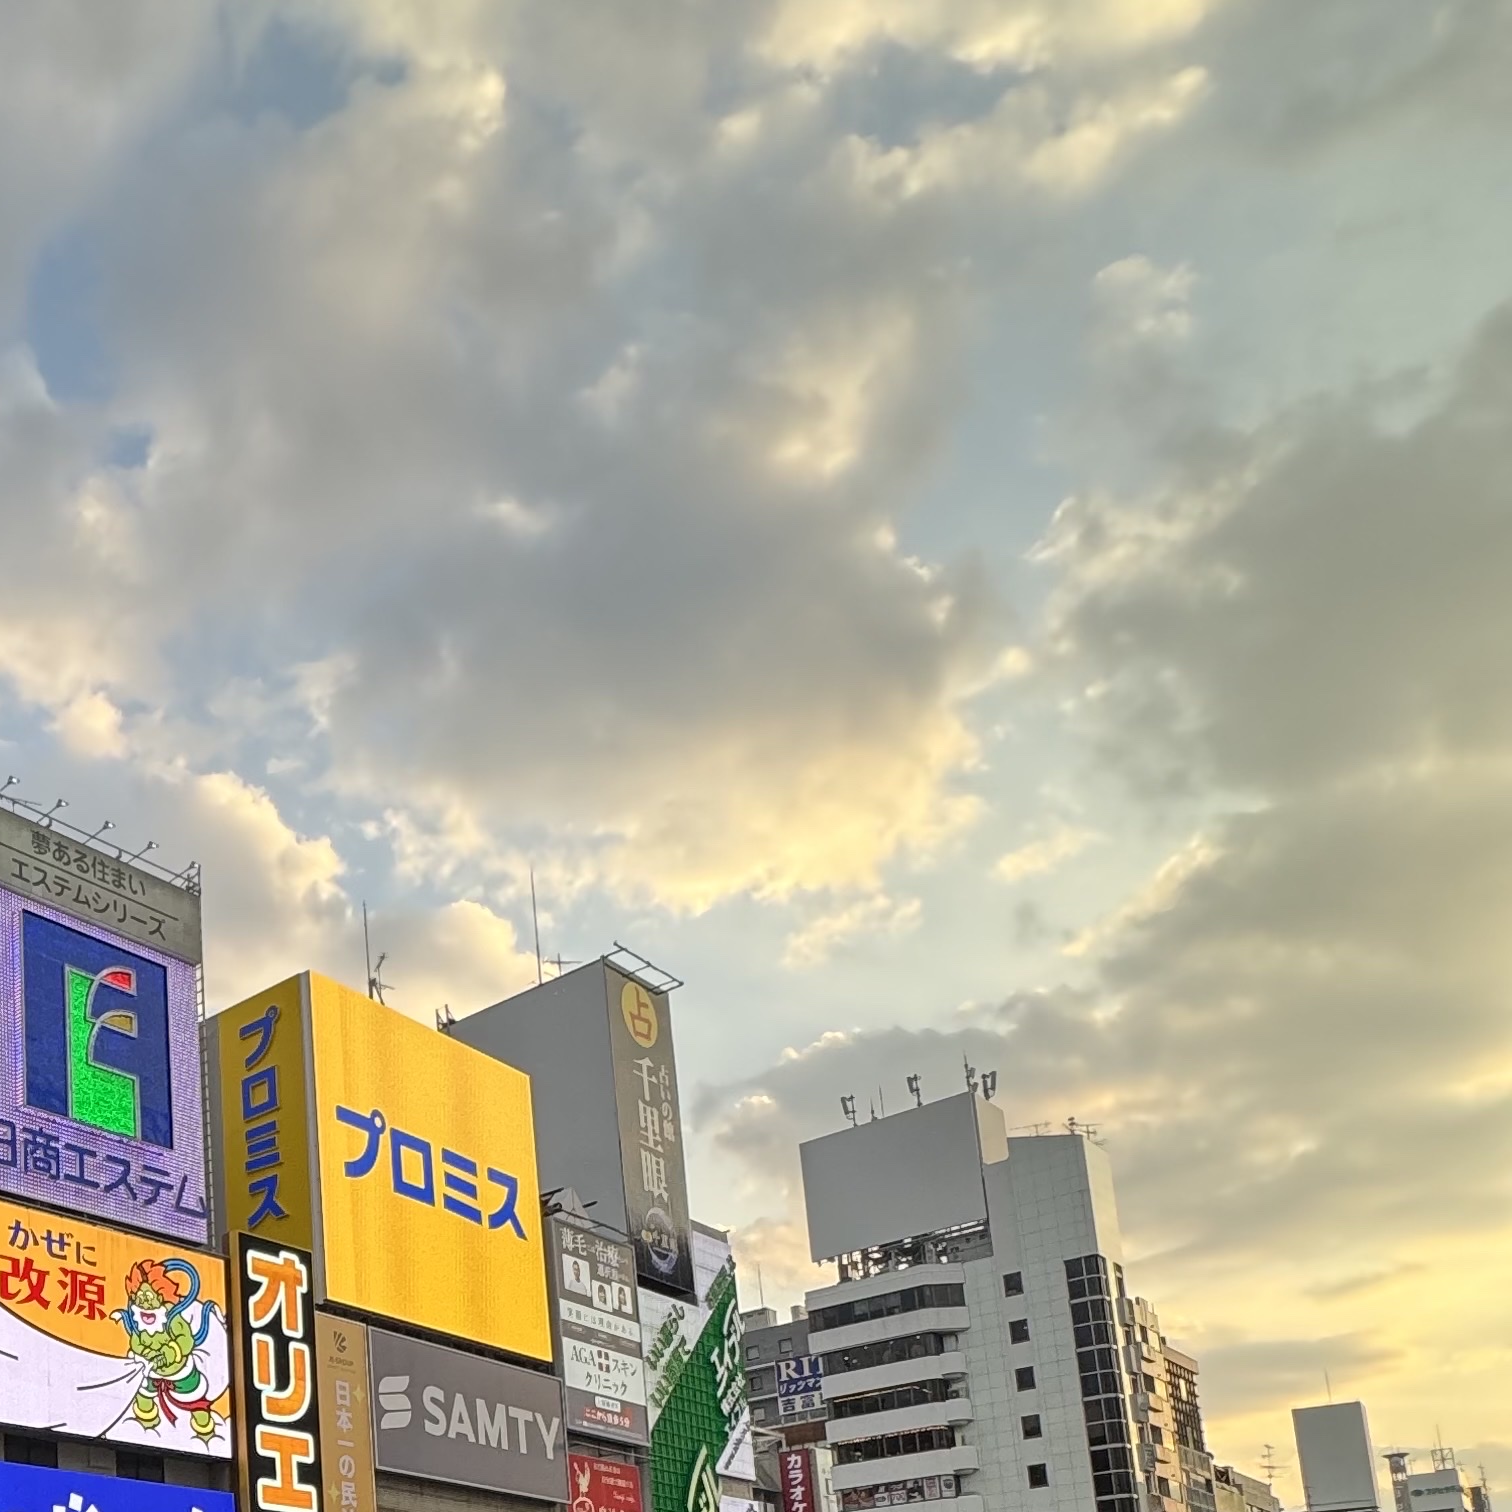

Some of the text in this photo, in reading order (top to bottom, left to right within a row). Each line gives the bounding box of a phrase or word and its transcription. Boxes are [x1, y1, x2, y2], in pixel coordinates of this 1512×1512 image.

[31, 829, 146, 897] 夢ある住まい
[11, 857, 166, 942] エステムシリーズ
[239, 1004, 287, 1229] プロミス
[335, 1105, 529, 1241] プロミス
[8, 1219, 98, 1267] かぜに
[571, 1345, 637, 1376] AGA スキン
[585, 1372, 627, 1396] クリニック
[422, 1385, 560, 1460] SAMTY
